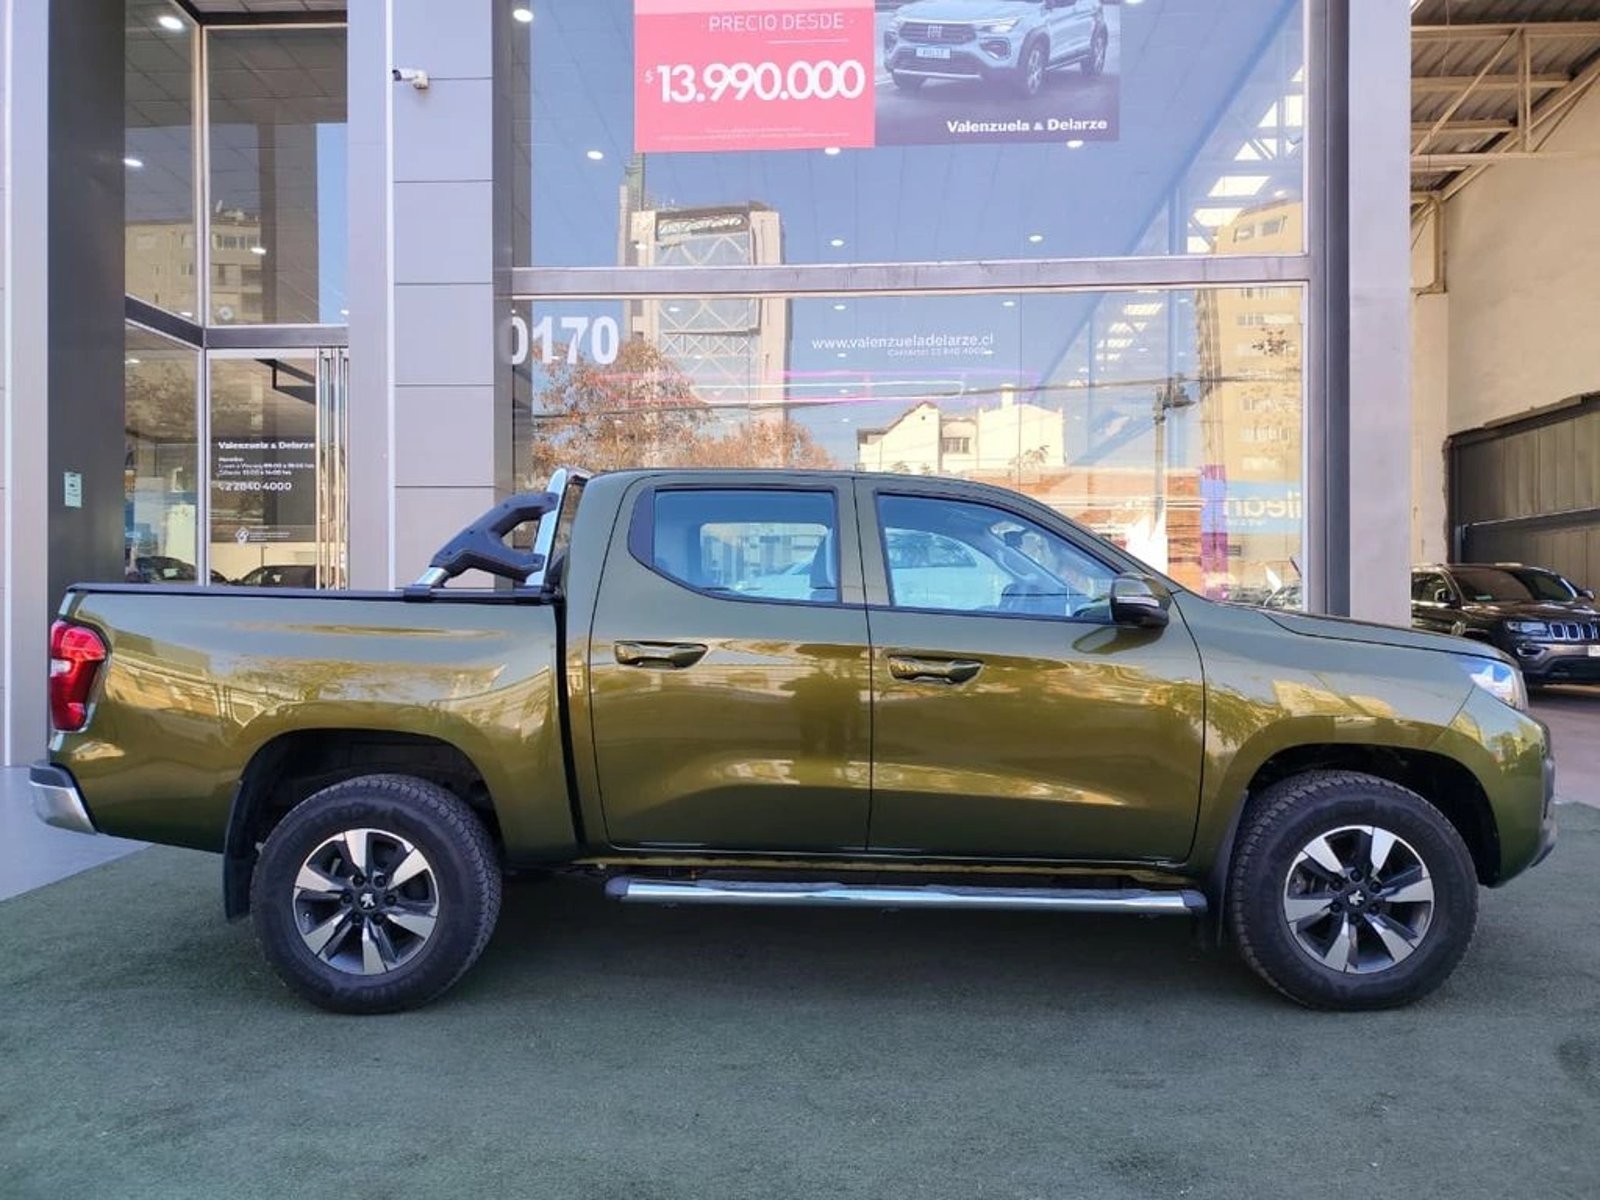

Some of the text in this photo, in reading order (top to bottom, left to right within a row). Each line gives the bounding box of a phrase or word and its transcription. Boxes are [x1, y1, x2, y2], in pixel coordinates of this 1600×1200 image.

[708, 12, 845, 32] PRECIO DESDE
[656, 59, 866, 104] 13.990.000
[946, 119, 1030, 133] Valenzuela
[1047, 118, 1108, 131] Delarze
[811, 332, 994, 349] www.valenzueladelarze.cl
